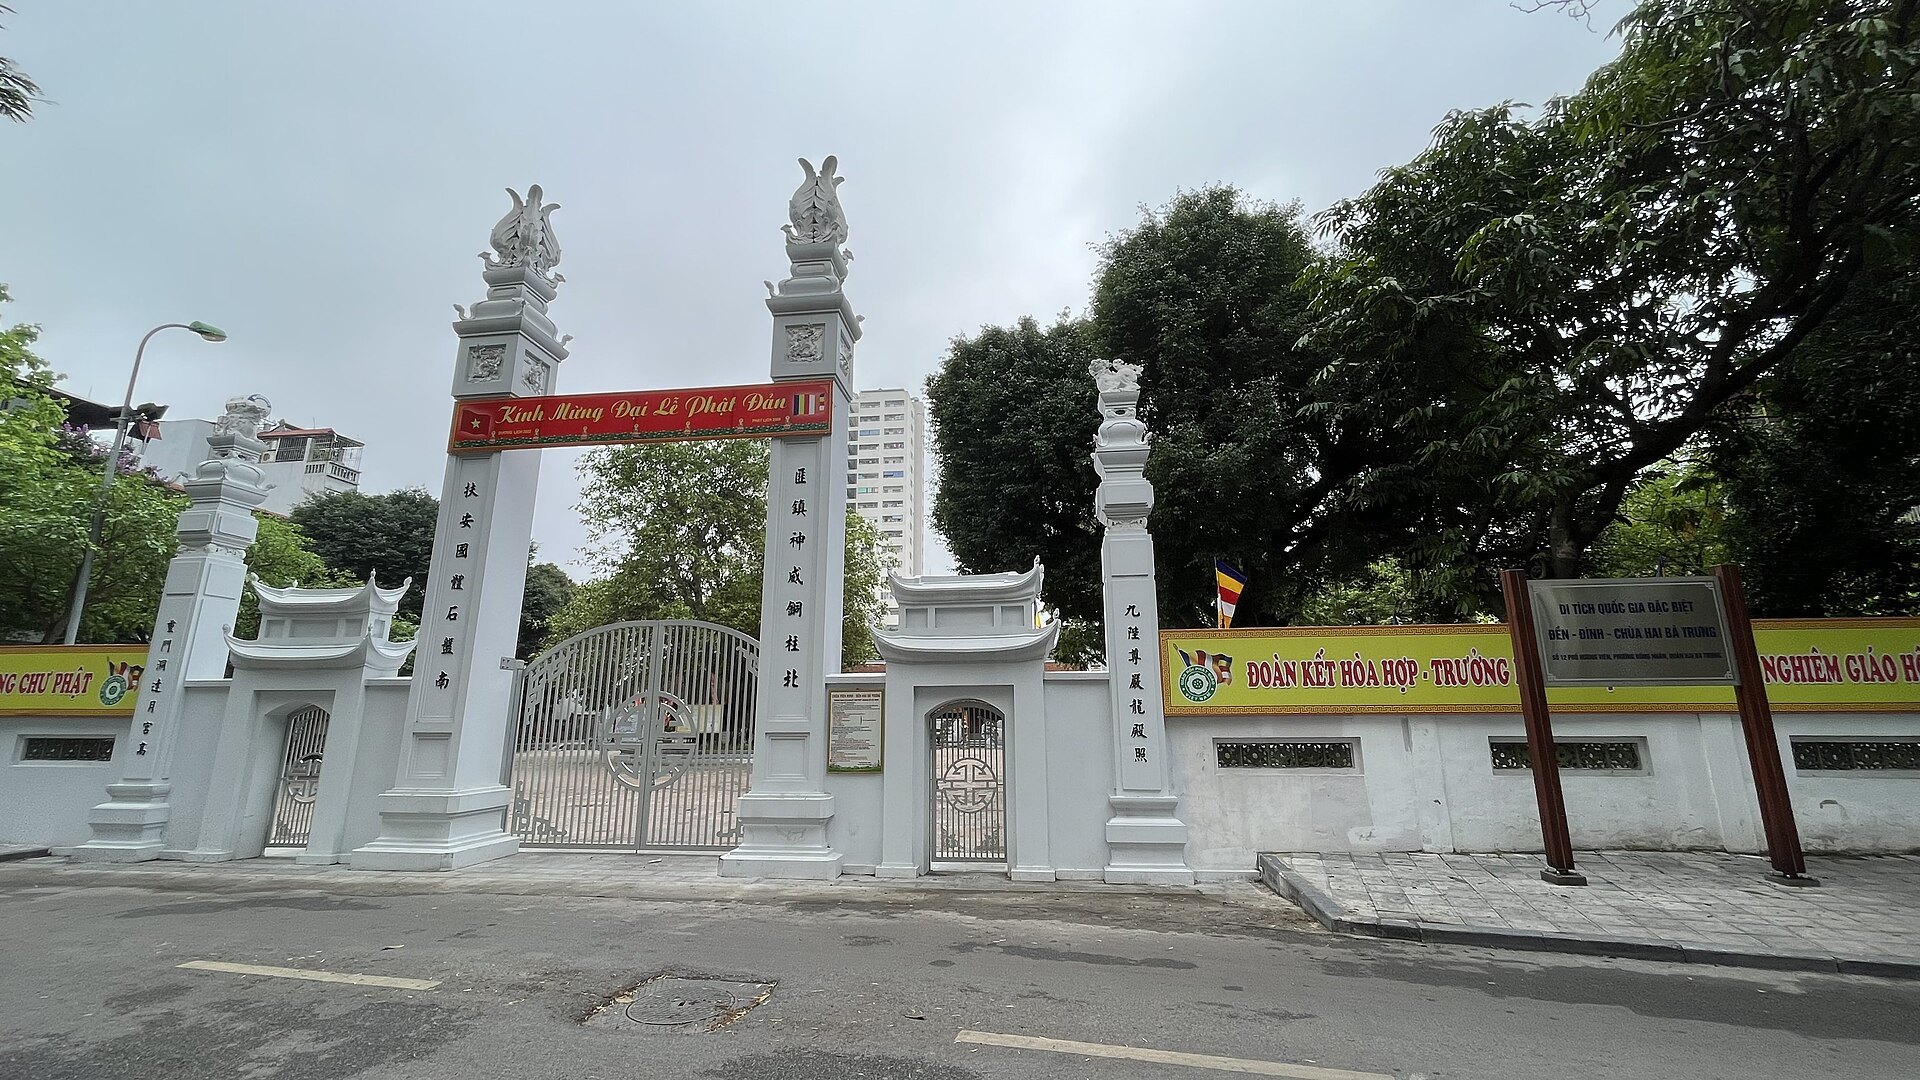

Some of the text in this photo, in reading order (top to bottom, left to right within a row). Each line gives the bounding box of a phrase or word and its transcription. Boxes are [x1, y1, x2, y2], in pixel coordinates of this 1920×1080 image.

[495, 404, 545, 424] Kính
[548, 402, 605, 423] Mừng
[611, 400, 649, 421] Đại
[653, 396, 679, 416] Lễ
[684, 395, 736, 418] Phật
[1559, 599, 1694, 615] DI TÍCH QUỐC GIA ĐẶC BIỆT
[1579, 626, 1605, 640] ĐÌNH
[1614, 625, 1642, 639] CHÙA
[1644, 627, 1663, 639] HAI
[1665, 624, 1680, 638] BÀ
[1681, 626, 1717, 638] TRƯNG
[1246, 653, 1297, 687] ĐOÀN
[1300, 648, 1336, 687] KẾT
[1340, 652, 1380, 686] HÒA
[1381, 656, 1418, 693] HỢP
[1430, 648, 1510, 686] TRƯỞNG
[1760, 646, 1843, 683] NGHIÊM
[1845, 646, 1898, 683] GIÁO
[19, 670, 53, 693] CHƯ
[52, 666, 93, 699] PHẬT
